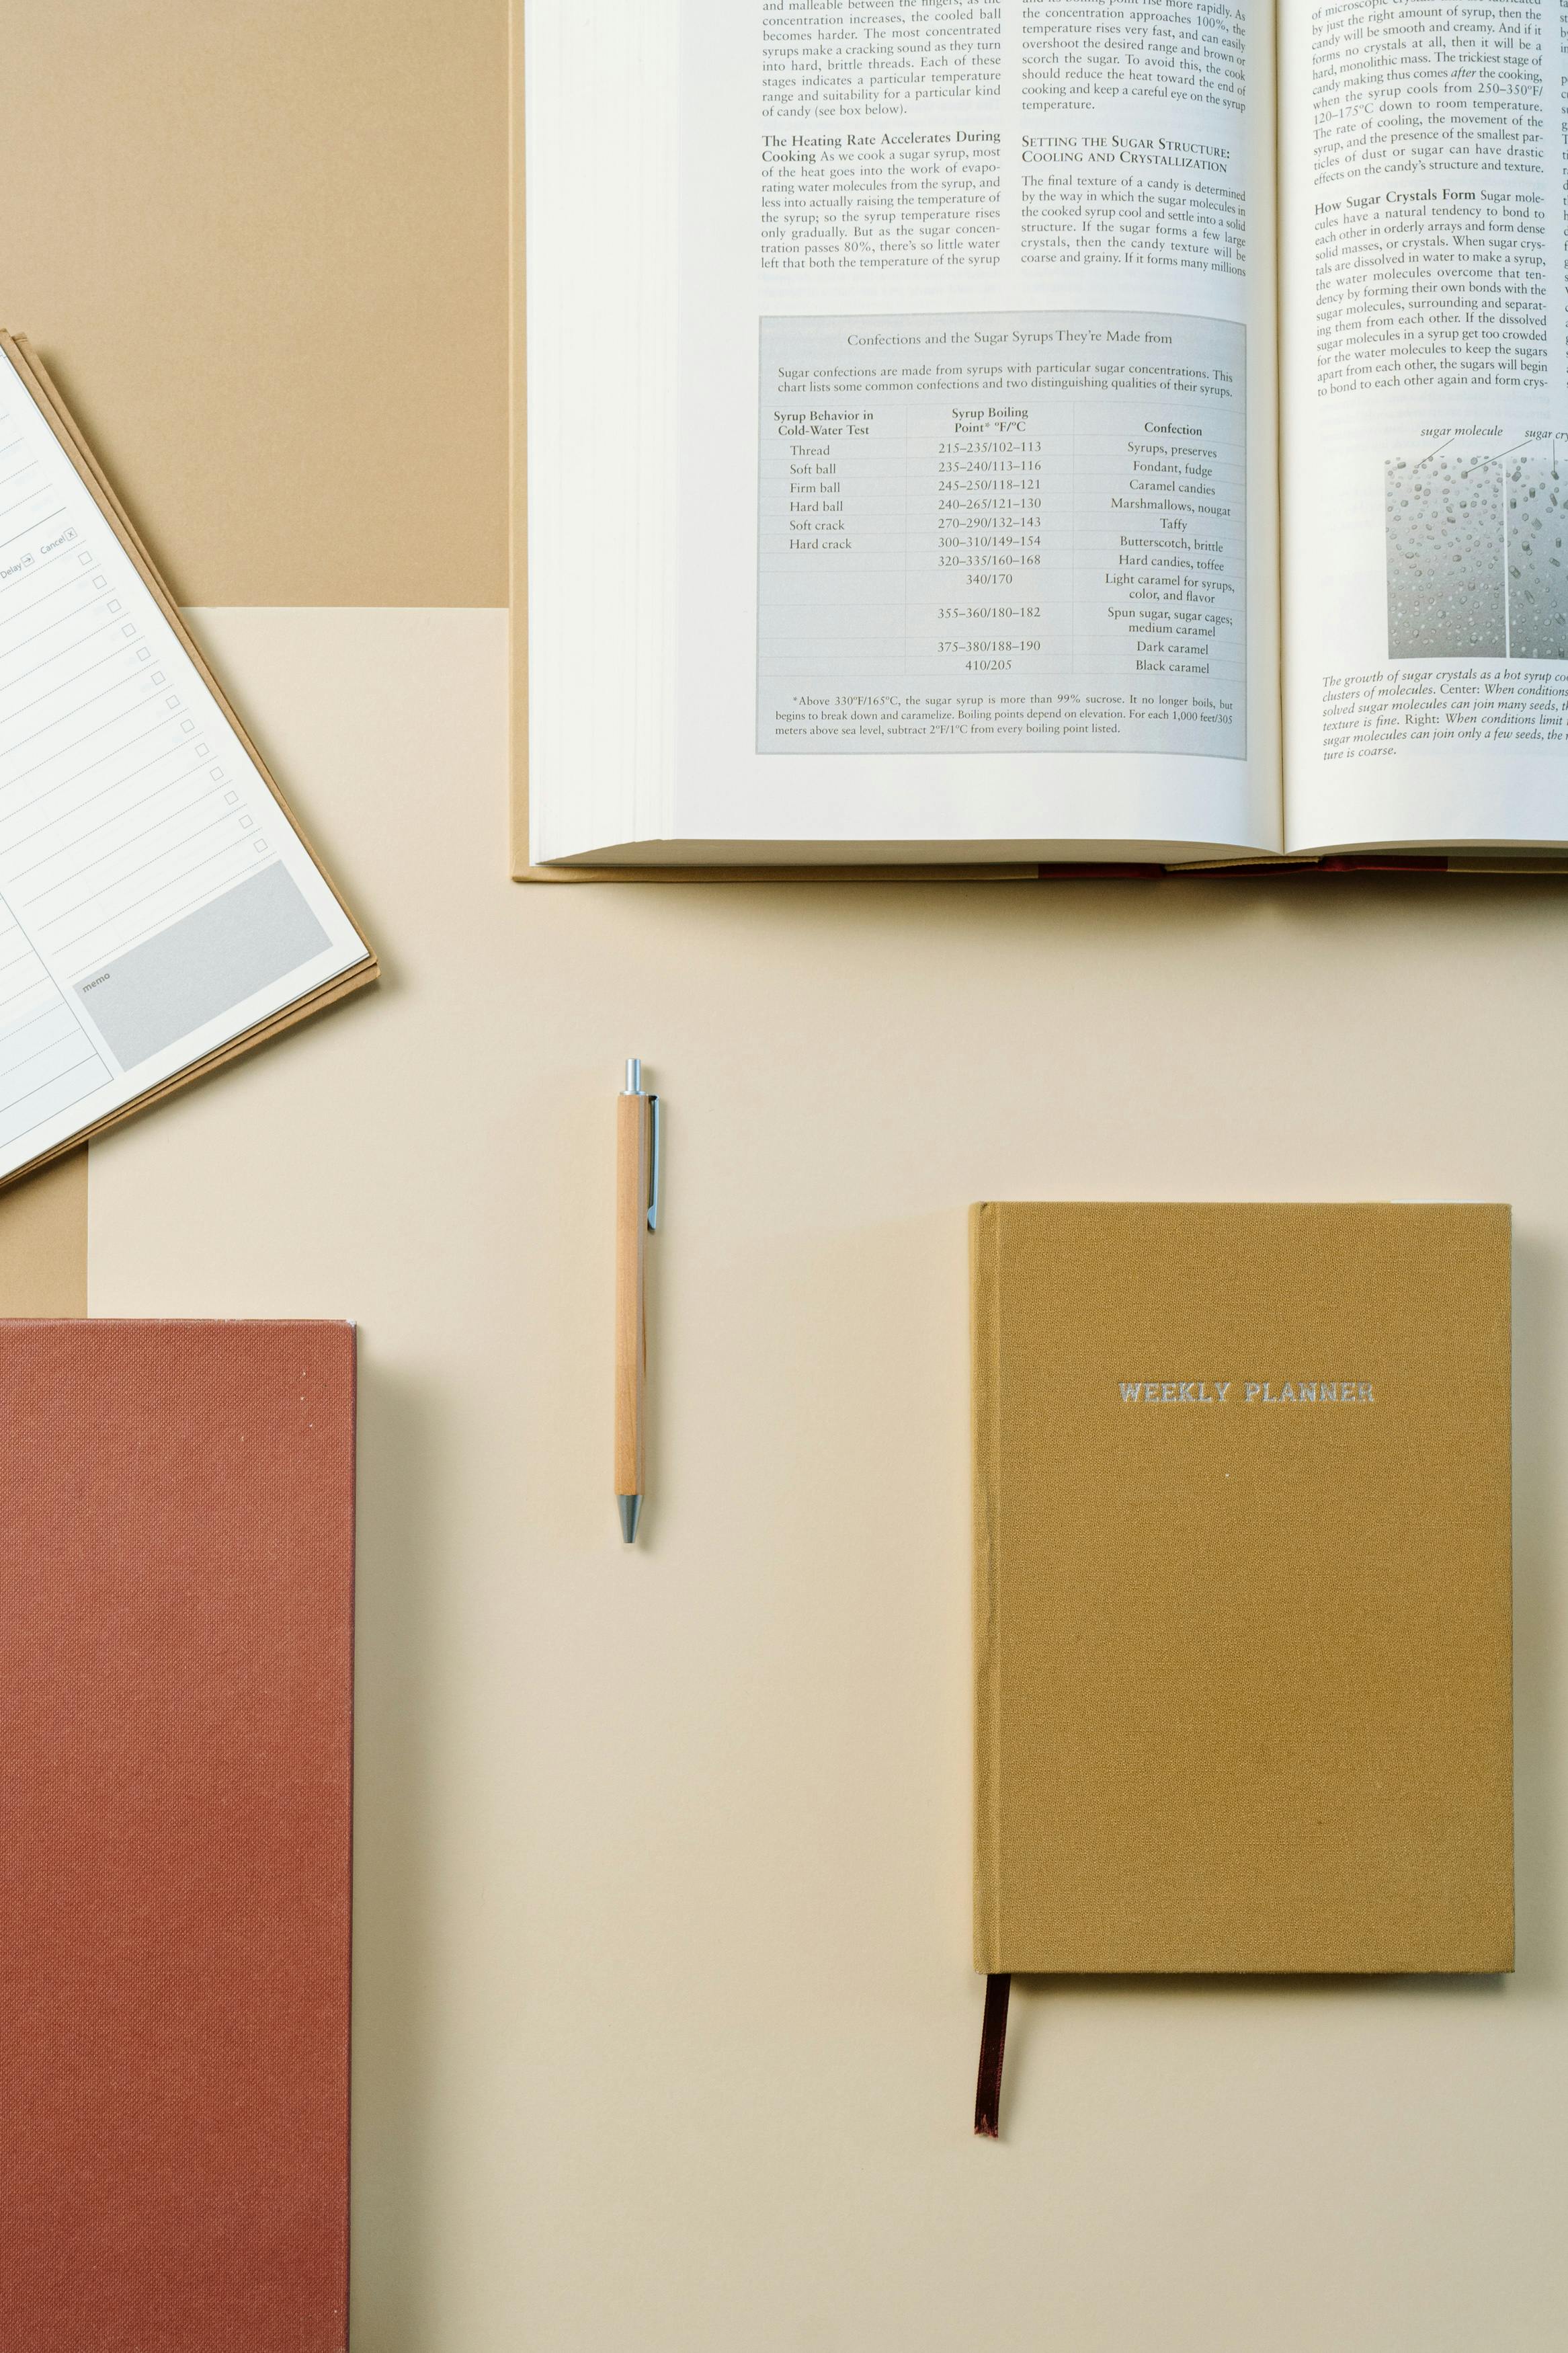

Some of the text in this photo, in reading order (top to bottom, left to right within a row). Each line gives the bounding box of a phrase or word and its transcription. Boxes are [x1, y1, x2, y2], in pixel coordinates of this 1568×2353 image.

[763, 8, 1000, 26] concentration increases, the cooled ball
[1313, 97, 1339, 110] when
[1346, 91, 1362, 102] the
[1368, 88, 1401, 100] syrup
[1407, 82, 1438, 94] cools
[1444, 82, 1472, 93] from
[1022, 102, 1094, 112] temperature.
[1380, 101, 1412, 112] down
[1473, 101, 1542, 112] temperature.
[762, 130, 1000, 149] The Heating Rate Accelerates During
[762, 151, 816, 164] Cooking
[821, 151, 834, 161] As
[858, 149, 884, 160] cook
[900, 151, 930, 161] sugar
[934, 151, 968, 161] syrup,
[973, 149, 1000, 157] most
[1315, 189, 1544, 215] How Sugar Crystals Form Sugar mole-
[848, 334, 921, 345] Confections
[925, 332, 946, 344] and
[952, 332, 969, 343] the
[975, 332, 1008, 346] Sugar
[1013, 331, 1053, 344] Syrups
[1107, 331, 1140, 342] Made
[1145, 331, 1171, 344] from
[779, 368, 809, 380] Sugar
[814, 366, 876, 377] confections
[902, 365, 931, 375] made
[936, 364, 962, 374] from
[967, 366, 1002, 376] syrups
[1007, 362, 1031, 373] with
[1036, 362, 1091, 375] particular
[1096, 366, 1125, 374] sugar
[1129, 366, 1209, 378] concentrations.
[1212, 370, 1233, 383] This
[774, 410, 873, 424] Syrup Behavior in
[952, 407, 1028, 420] Syrup Boiling
[778, 425, 869, 436] Cold-Water Test
[1145, 422, 1202, 436] Confection
[1421, 425, 1503, 438] sugar molecule
[1525, 430, 1553, 440] sugar
[790, 445, 829, 455] Thread
[1128, 442, 1216, 458] Syrups, preserves
[790, 463, 835, 474] Soft ball
[1134, 461, 1212, 478] Fondant, fudge
[790, 482, 839, 493] Firm ball
[1130, 479, 1215, 495] Caramel candies
[790, 501, 842, 512] Hard ball
[1111, 498, 1231, 517] Marshmallows, nougat
[790, 520, 844, 530] Soft crack
[1160, 518, 1187, 532] Taffy
[40, 535, 66, 554] Cancel
[790, 539, 852, 549] Hard crack
[1121, 536, 1223, 552] Butterscotch, brittle
[1119, 555, 1224, 571] Hard candies, toffee
[0, 563, 22, 579] Delay
[966, 574, 1012, 584] 340/170
[1106, 573, 1235, 593] Light caramel for syrups,
[1130, 588, 1215, 603] color, and flavor
[1108, 607, 1232, 626] Spun sugar, sugar cages;
[1129, 622, 1215, 637] medium caramel
[1137, 641, 1208, 655] Dark caramel
[966, 660, 1012, 670] 410/205
[1137, 660, 1209, 674] Black caramel
[810, 725, 838, 734] above
[860, 725, 884, 735] level,
[887, 725, 926, 734] subtract
[971, 724, 993, 733] from
[997, 727, 1022, 735] every
[1027, 723, 1060, 735] boiling
[1063, 724, 1088, 735] point
[1092, 723, 1120, 733] listed.
[1324, 748, 1396, 760] ture is coarse.
[82, 973, 110, 993] memo
[1118, 1380, 1374, 1402] WEEKLY PLANNER
